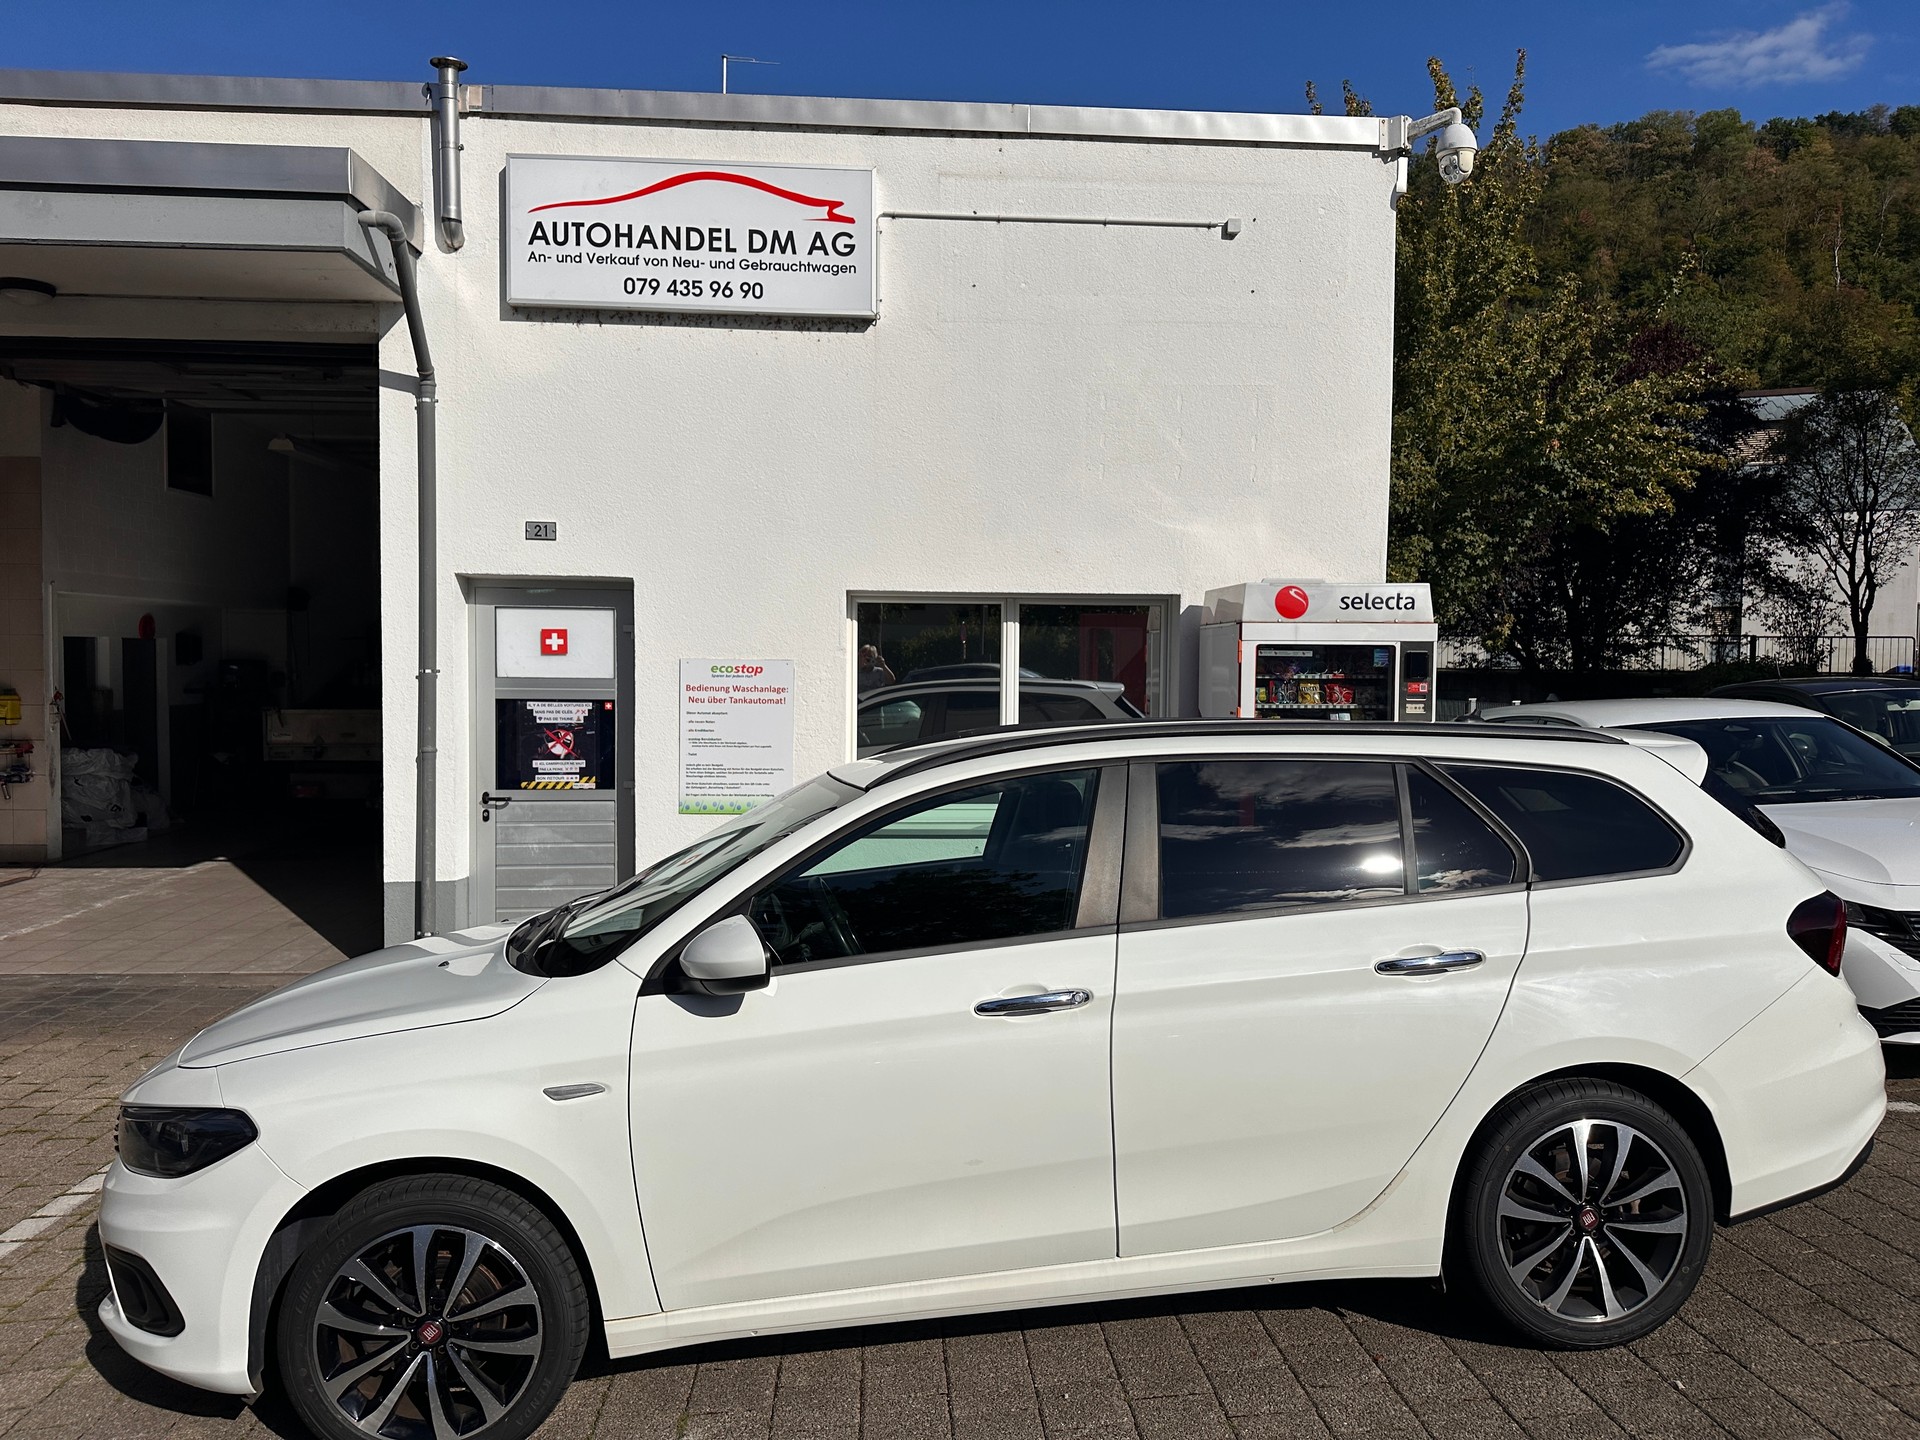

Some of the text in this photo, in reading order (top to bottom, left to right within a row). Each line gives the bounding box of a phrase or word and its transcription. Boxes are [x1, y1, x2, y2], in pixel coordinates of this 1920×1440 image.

[528, 221, 856, 257] AUTOHANDEL DM AG
[528, 250, 857, 276] An- und Verkauf von Neu- und Gebrauchtwagen
[623, 277, 764, 299] 079 435 96 90
[534, 524, 548, 537] 21
[1339, 592, 1415, 610] selecta
[710, 664, 764, 676] ecostop
[686, 684, 789, 694] Bedienung Waschanlage:
[688, 696, 786, 705] Neu über Tankautomat!
[422, 1324, 439, 1341] FIAT
